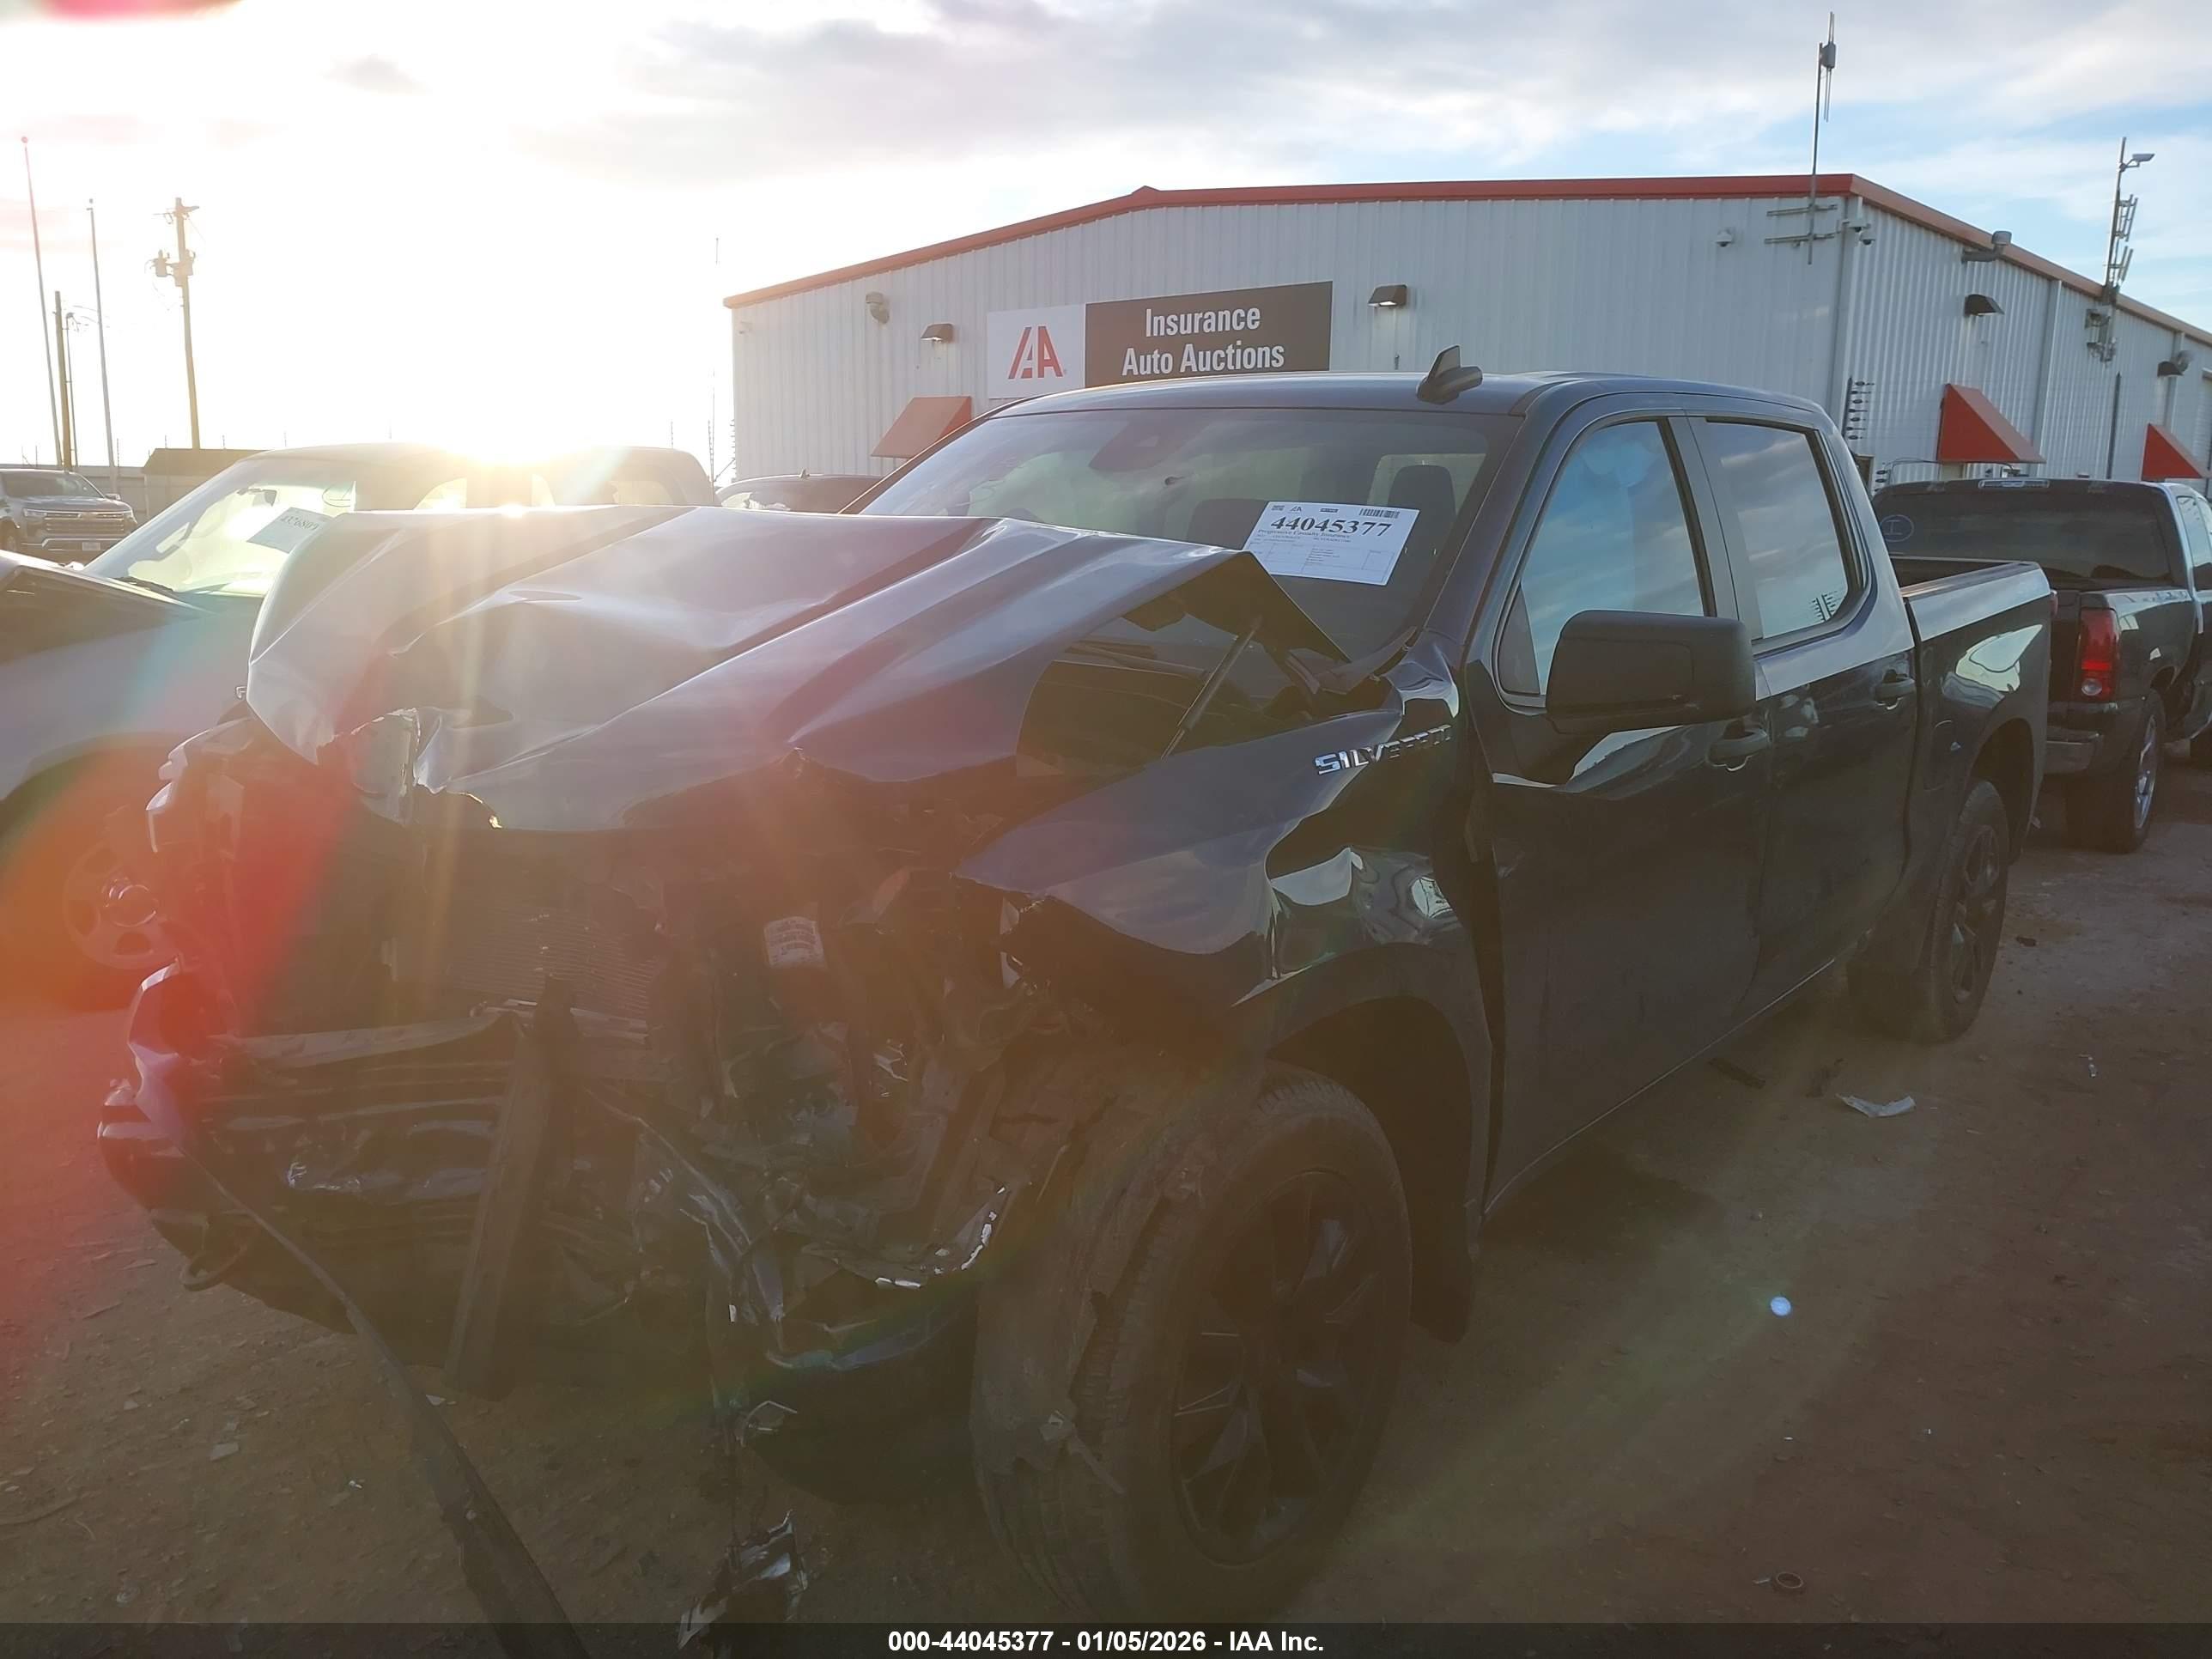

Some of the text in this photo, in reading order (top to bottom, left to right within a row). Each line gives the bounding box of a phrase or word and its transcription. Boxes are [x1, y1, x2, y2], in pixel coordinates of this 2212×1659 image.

[1146, 307, 1261, 337] Insurance
[1121, 340, 1285, 376] Auto Auctions
[1271, 516, 1392, 537] 44045377
